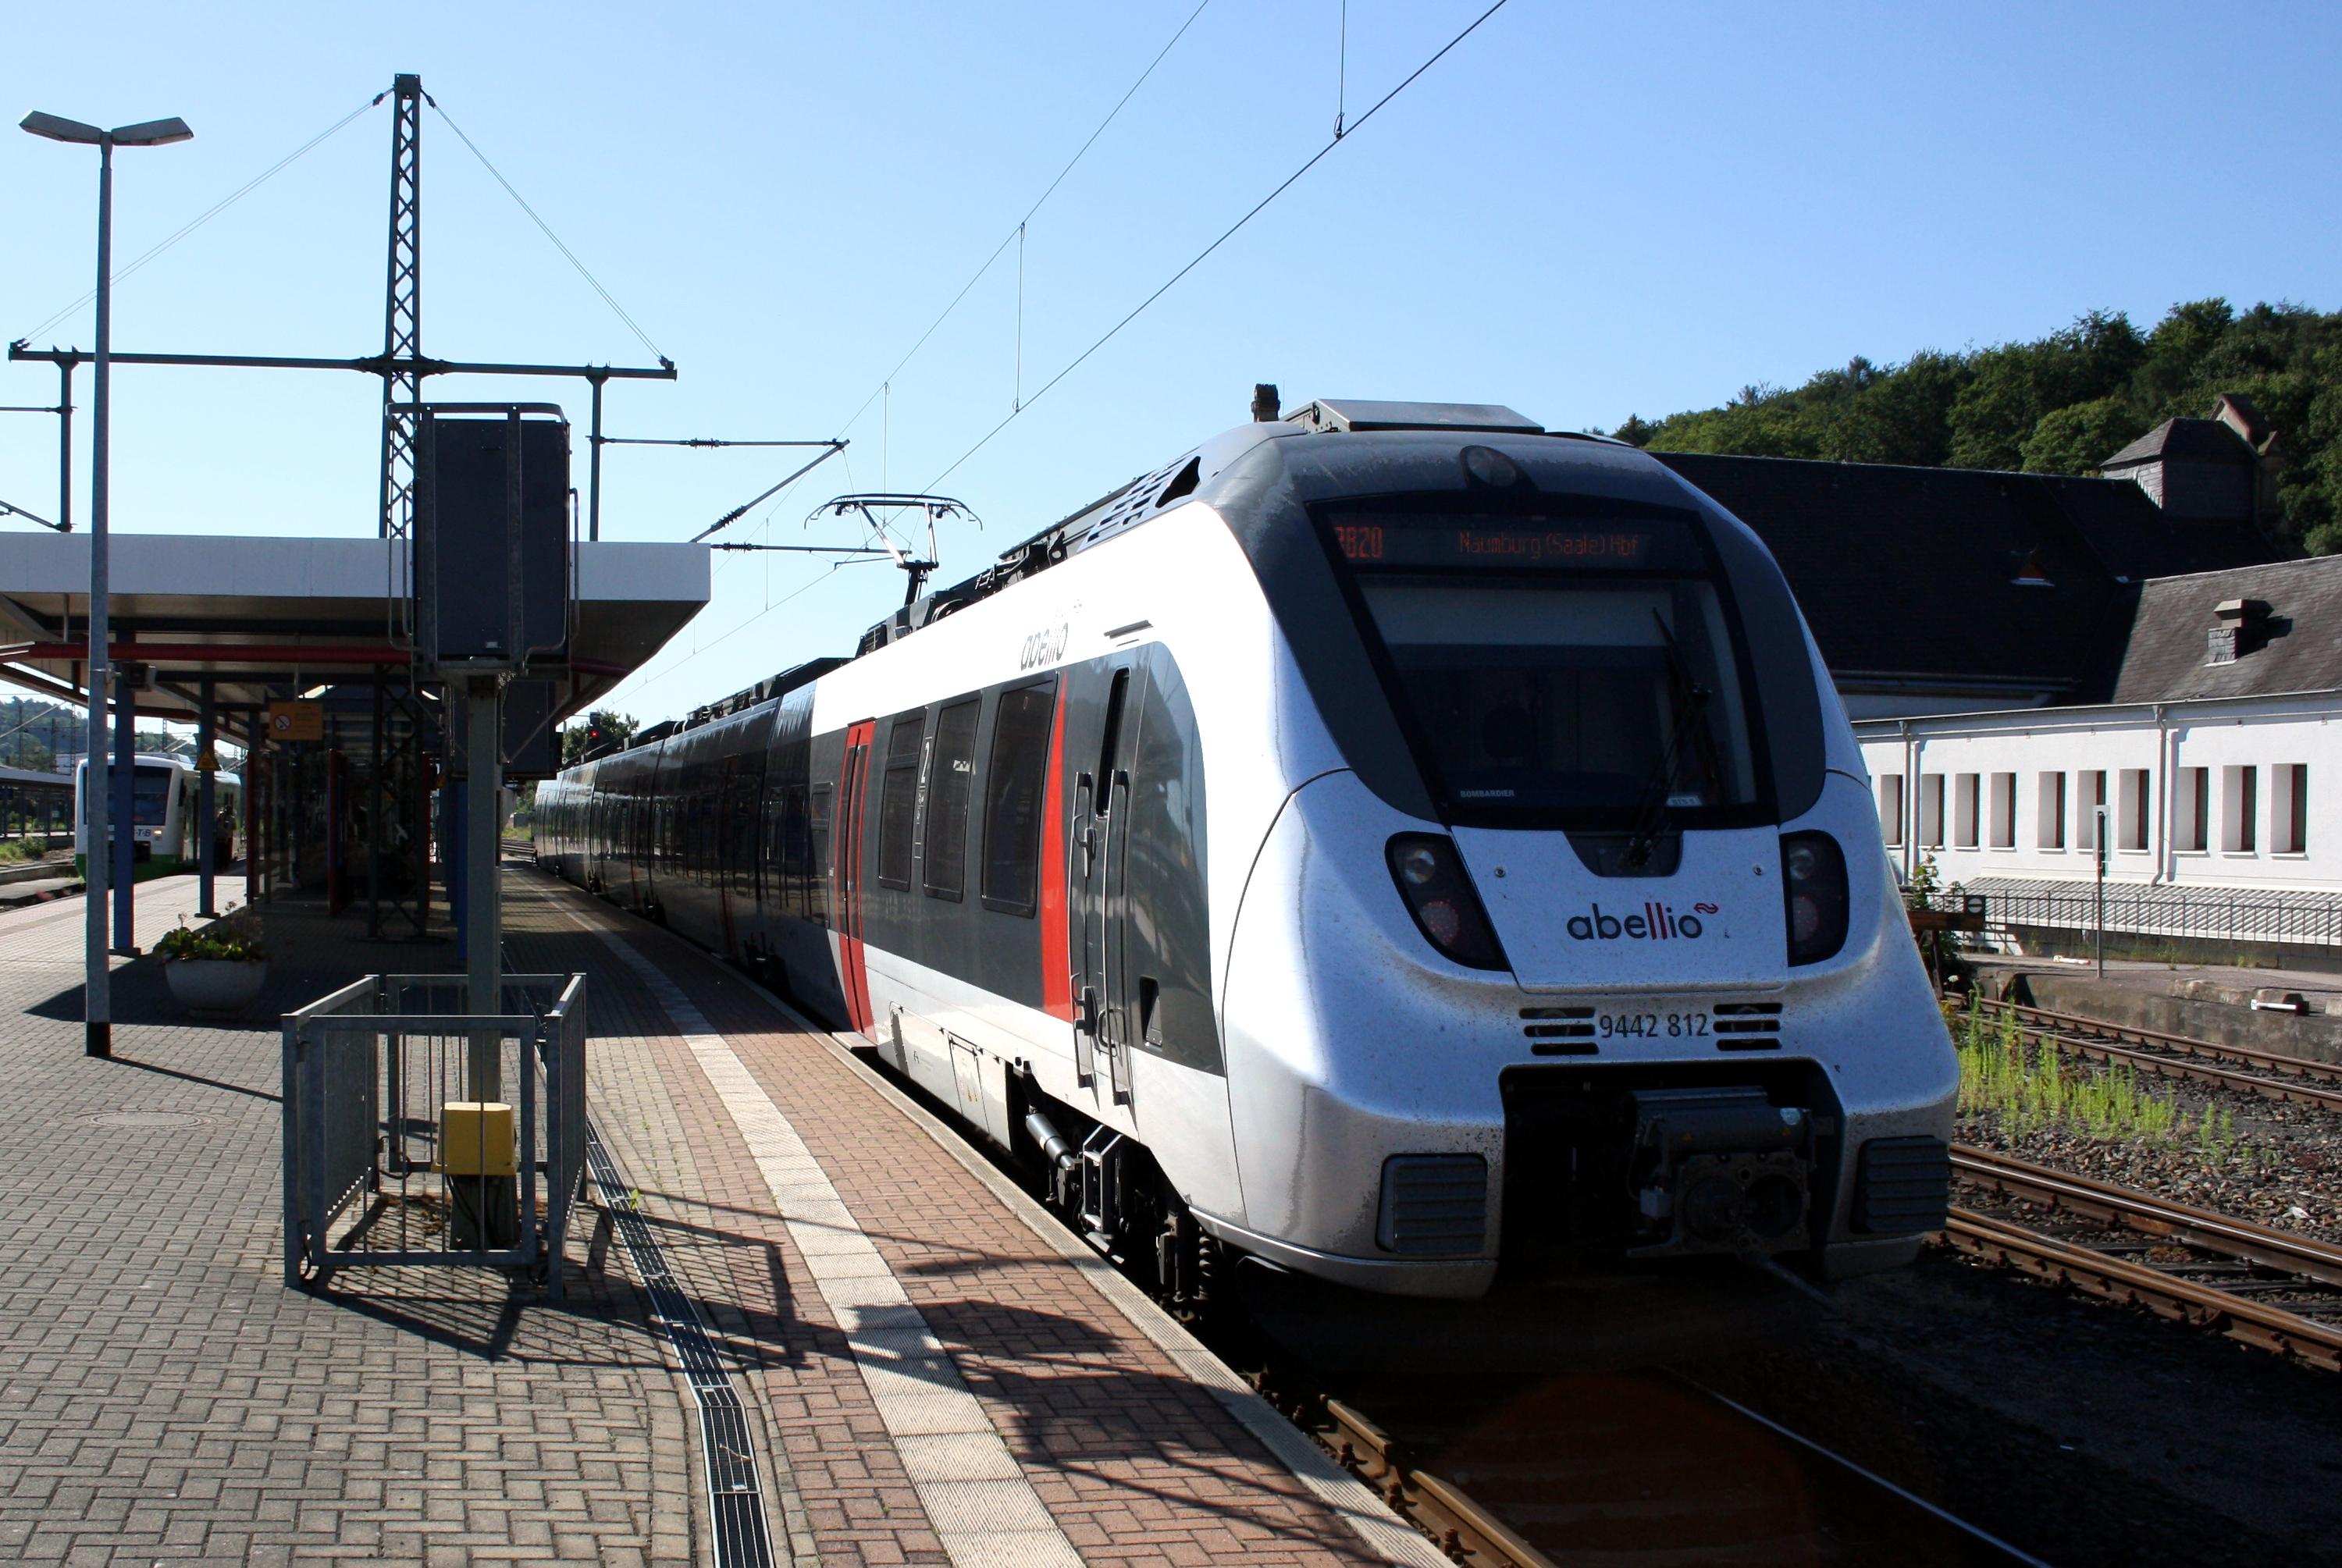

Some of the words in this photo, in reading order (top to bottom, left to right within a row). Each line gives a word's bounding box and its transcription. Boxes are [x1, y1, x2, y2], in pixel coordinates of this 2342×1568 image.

[1459, 531, 1541, 560] Naumburg
[1546, 532, 1606, 555] (Saale)
[1611, 533, 1639, 556] Hbf
[1460, 789, 1514, 798] BOMBARDIER
[1567, 902, 1703, 940] abellio
[1600, 1014, 1659, 1039] 9442
[1668, 1013, 1710, 1037] 812
